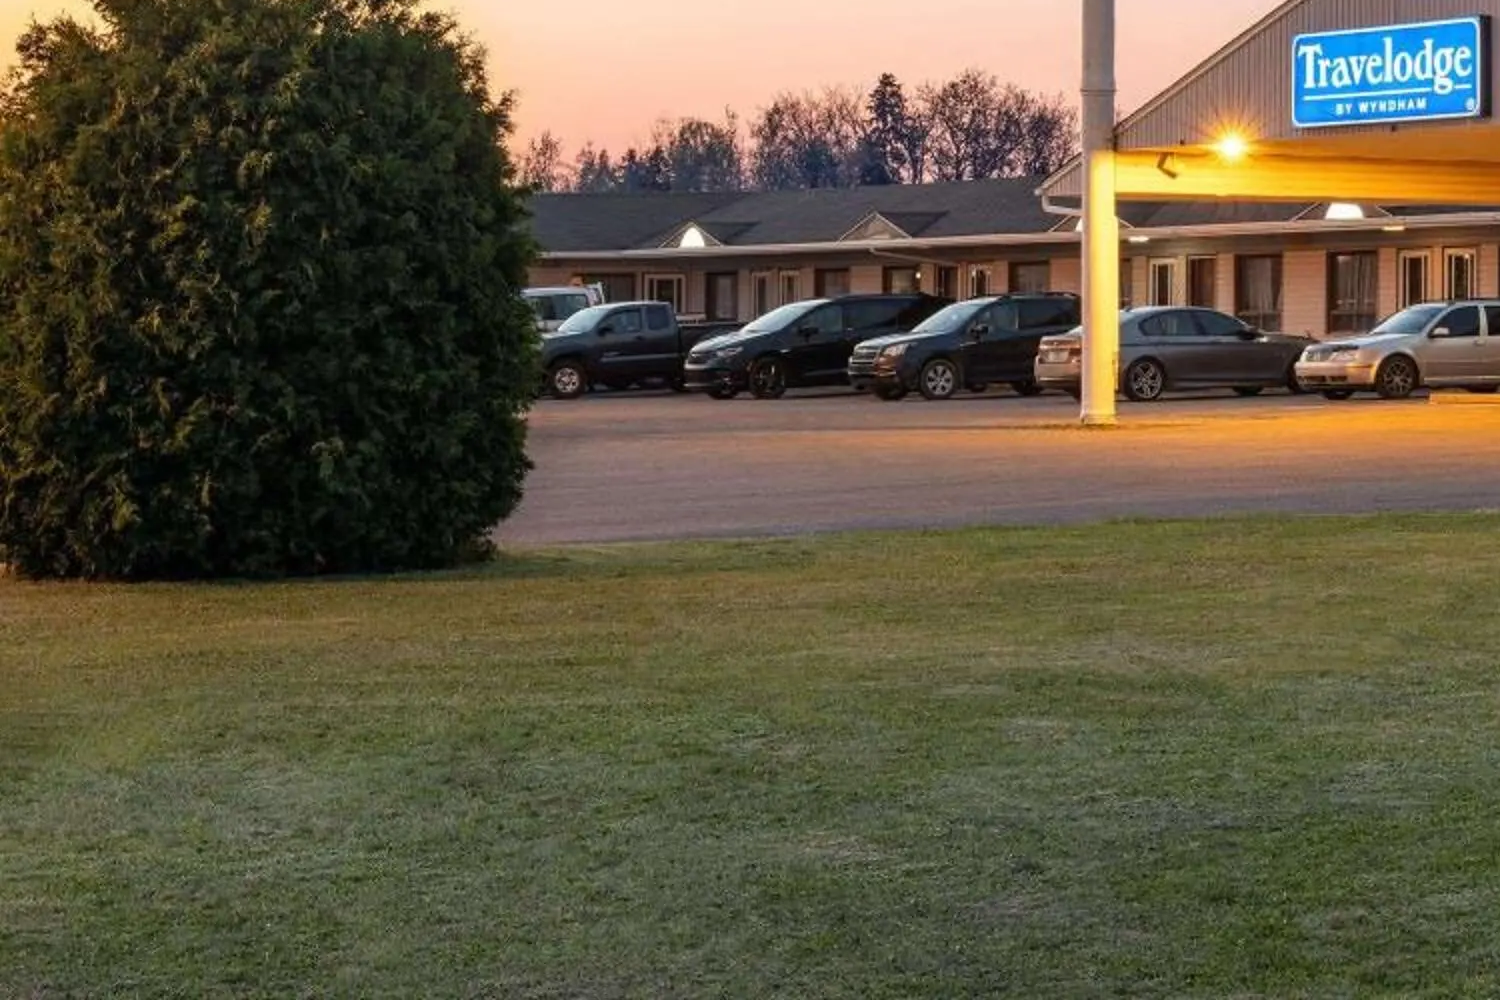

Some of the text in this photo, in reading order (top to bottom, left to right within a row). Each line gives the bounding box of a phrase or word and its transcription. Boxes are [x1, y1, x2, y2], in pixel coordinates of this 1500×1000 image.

[1298, 37, 1472, 94] Travelodge
[1335, 98, 1427, 116] BY WYNDHAM
